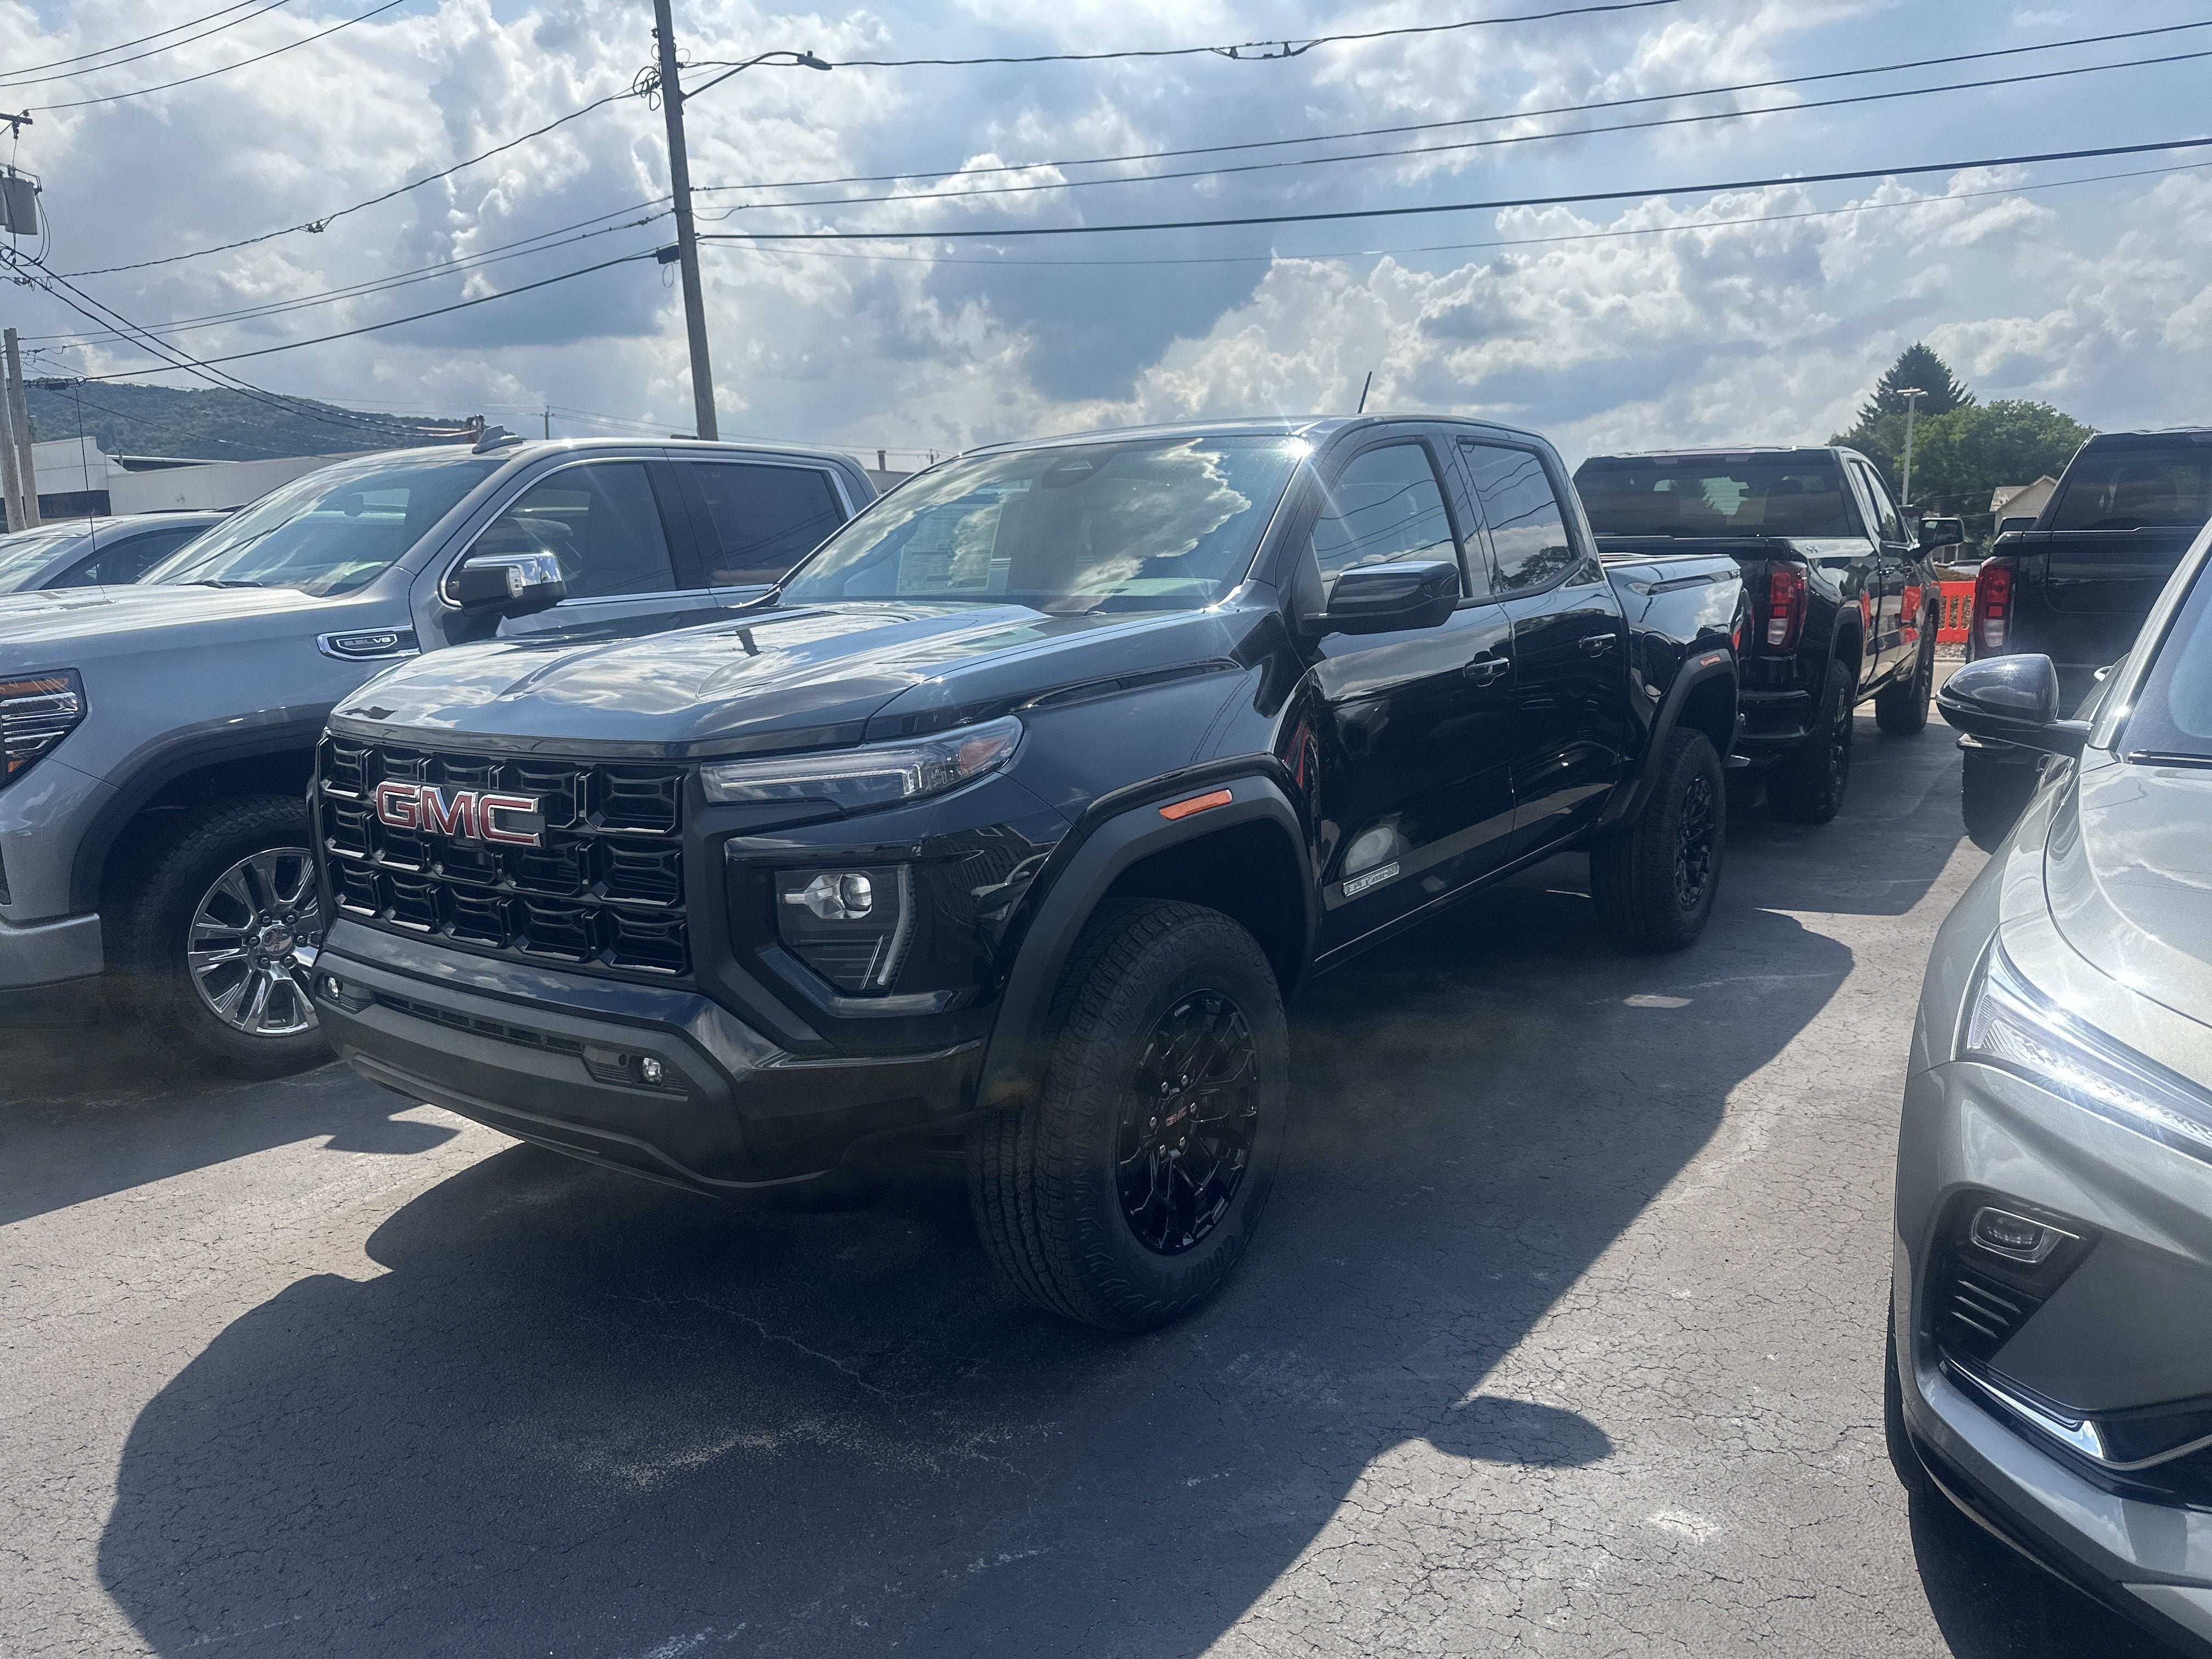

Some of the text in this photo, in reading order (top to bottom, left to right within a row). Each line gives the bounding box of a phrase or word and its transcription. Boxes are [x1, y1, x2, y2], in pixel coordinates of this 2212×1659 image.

[376, 780, 541, 848] GMC
[1348, 864, 1397, 893] ELEVATION
[273, 928, 282, 952] GMC
[1166, 1105, 1187, 1126] GMC
